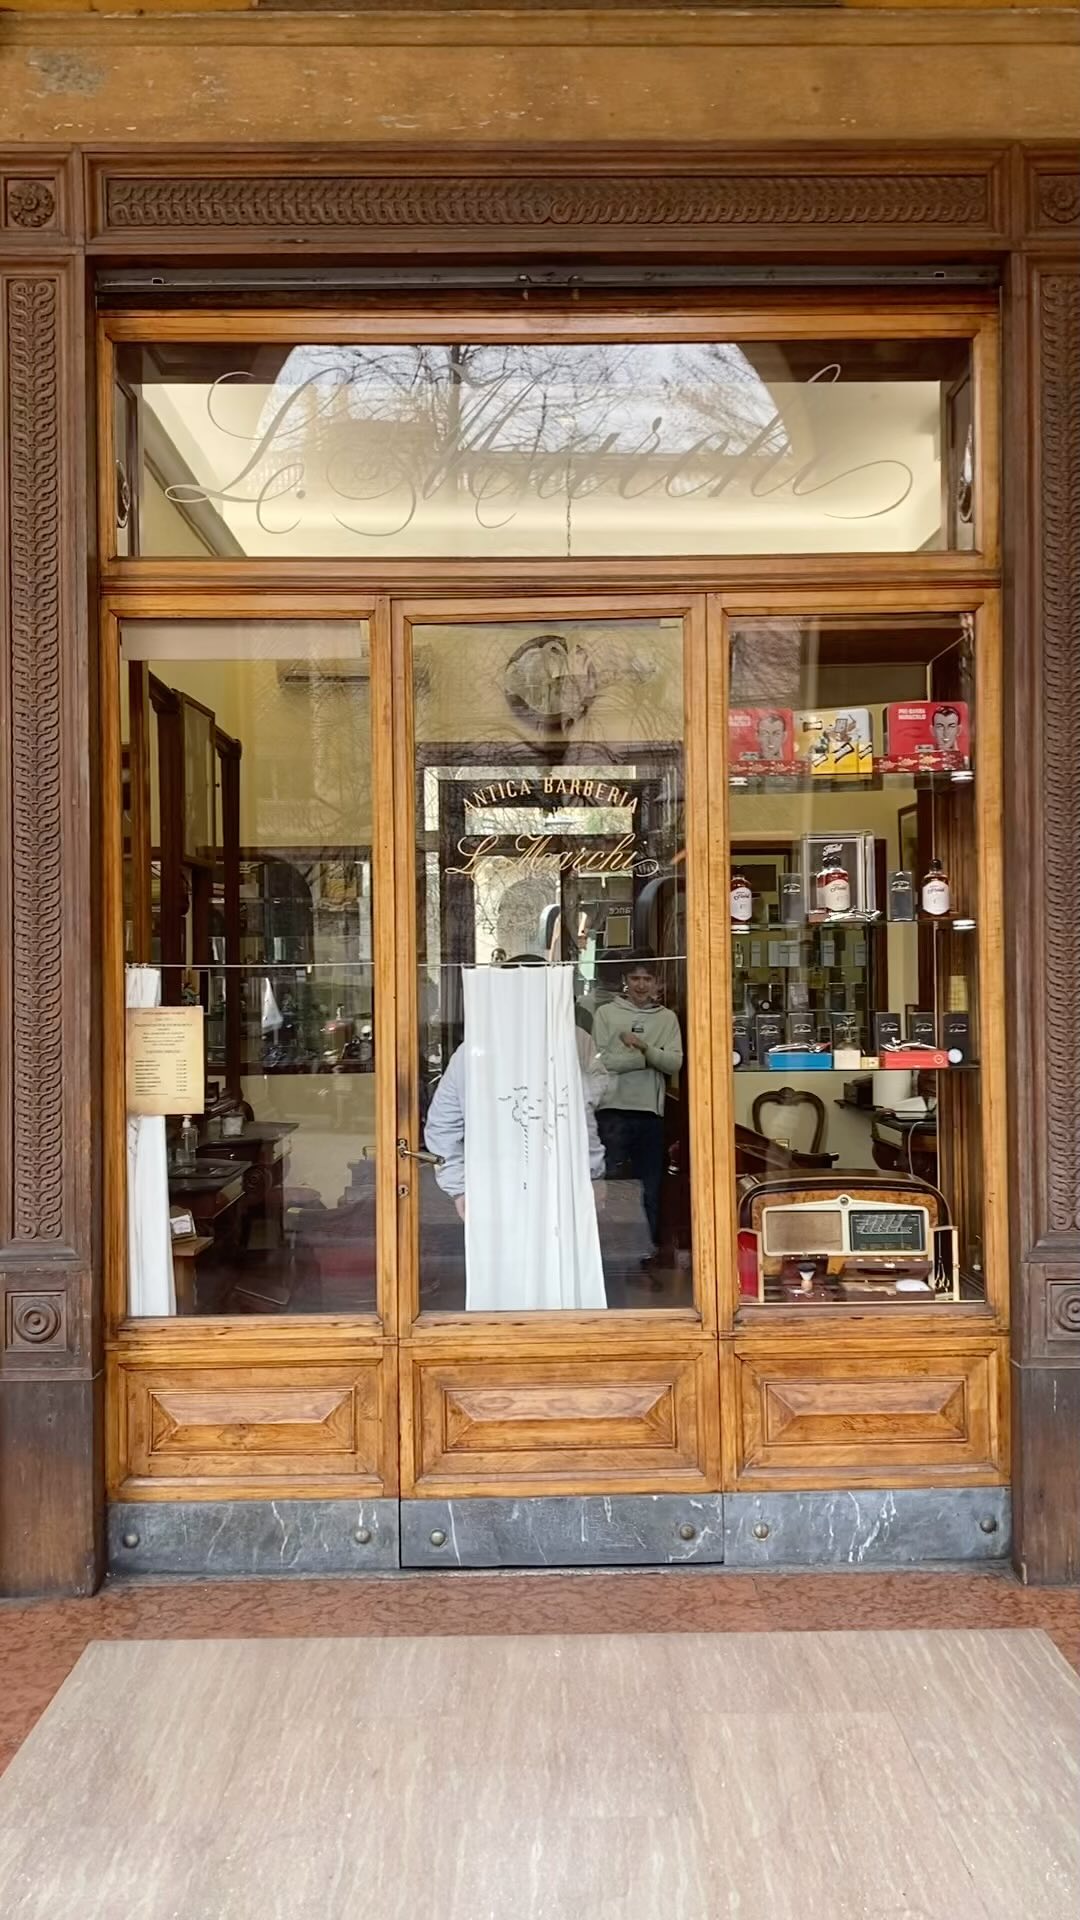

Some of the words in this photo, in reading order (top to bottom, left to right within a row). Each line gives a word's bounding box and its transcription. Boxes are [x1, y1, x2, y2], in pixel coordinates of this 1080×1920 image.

[326, 363, 914, 536] Marchi
[462, 780, 531, 815] ANTICA
[543, 777, 638, 814] BARBERIA
[495, 833, 659, 878] Marchi
